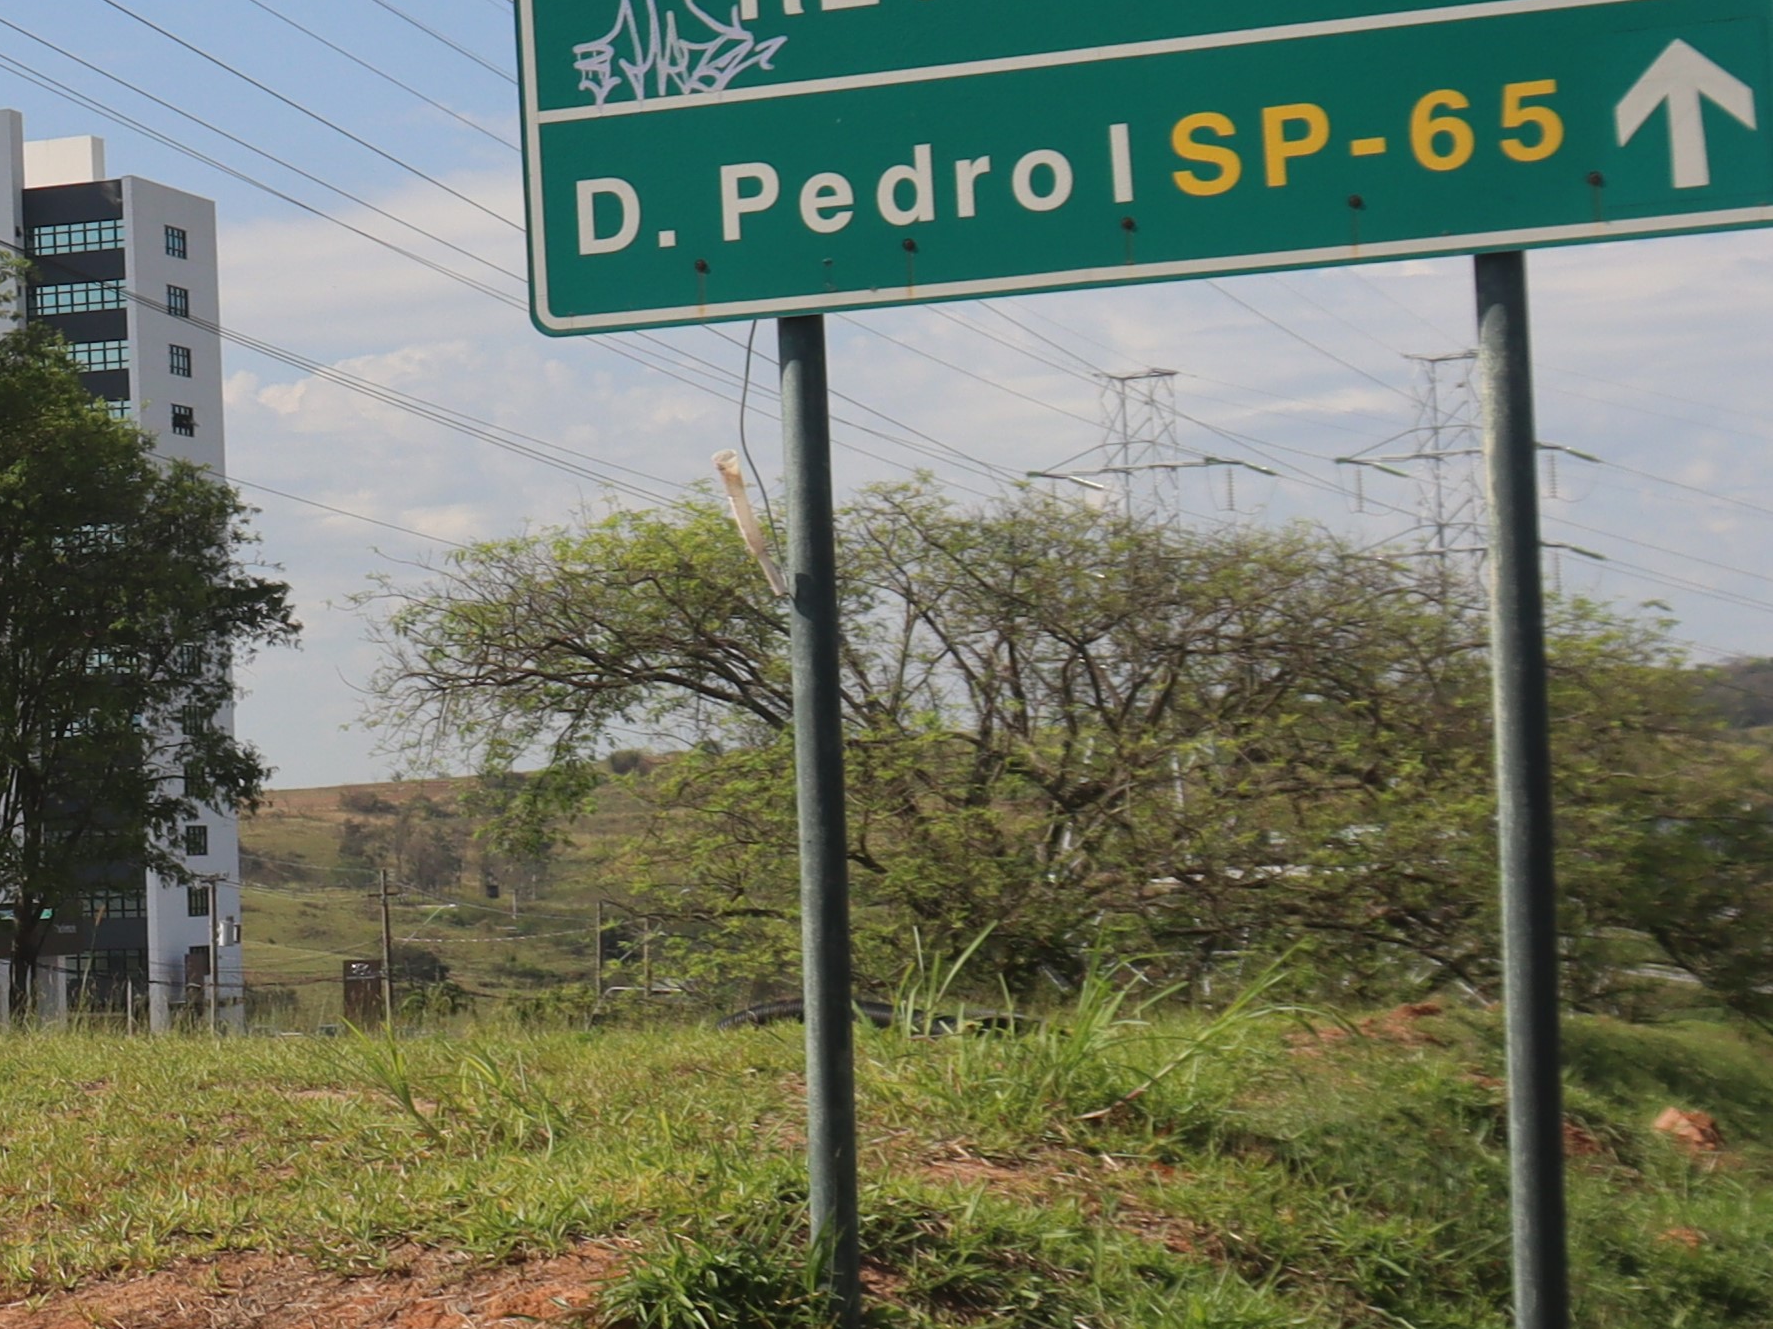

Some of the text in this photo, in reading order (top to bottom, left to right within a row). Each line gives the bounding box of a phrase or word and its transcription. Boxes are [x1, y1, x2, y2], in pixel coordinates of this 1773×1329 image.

[576, 177, 676, 256] D.
[720, 143, 1073, 242] Pedro
[1172, 79, 1563, 196] SP-65
